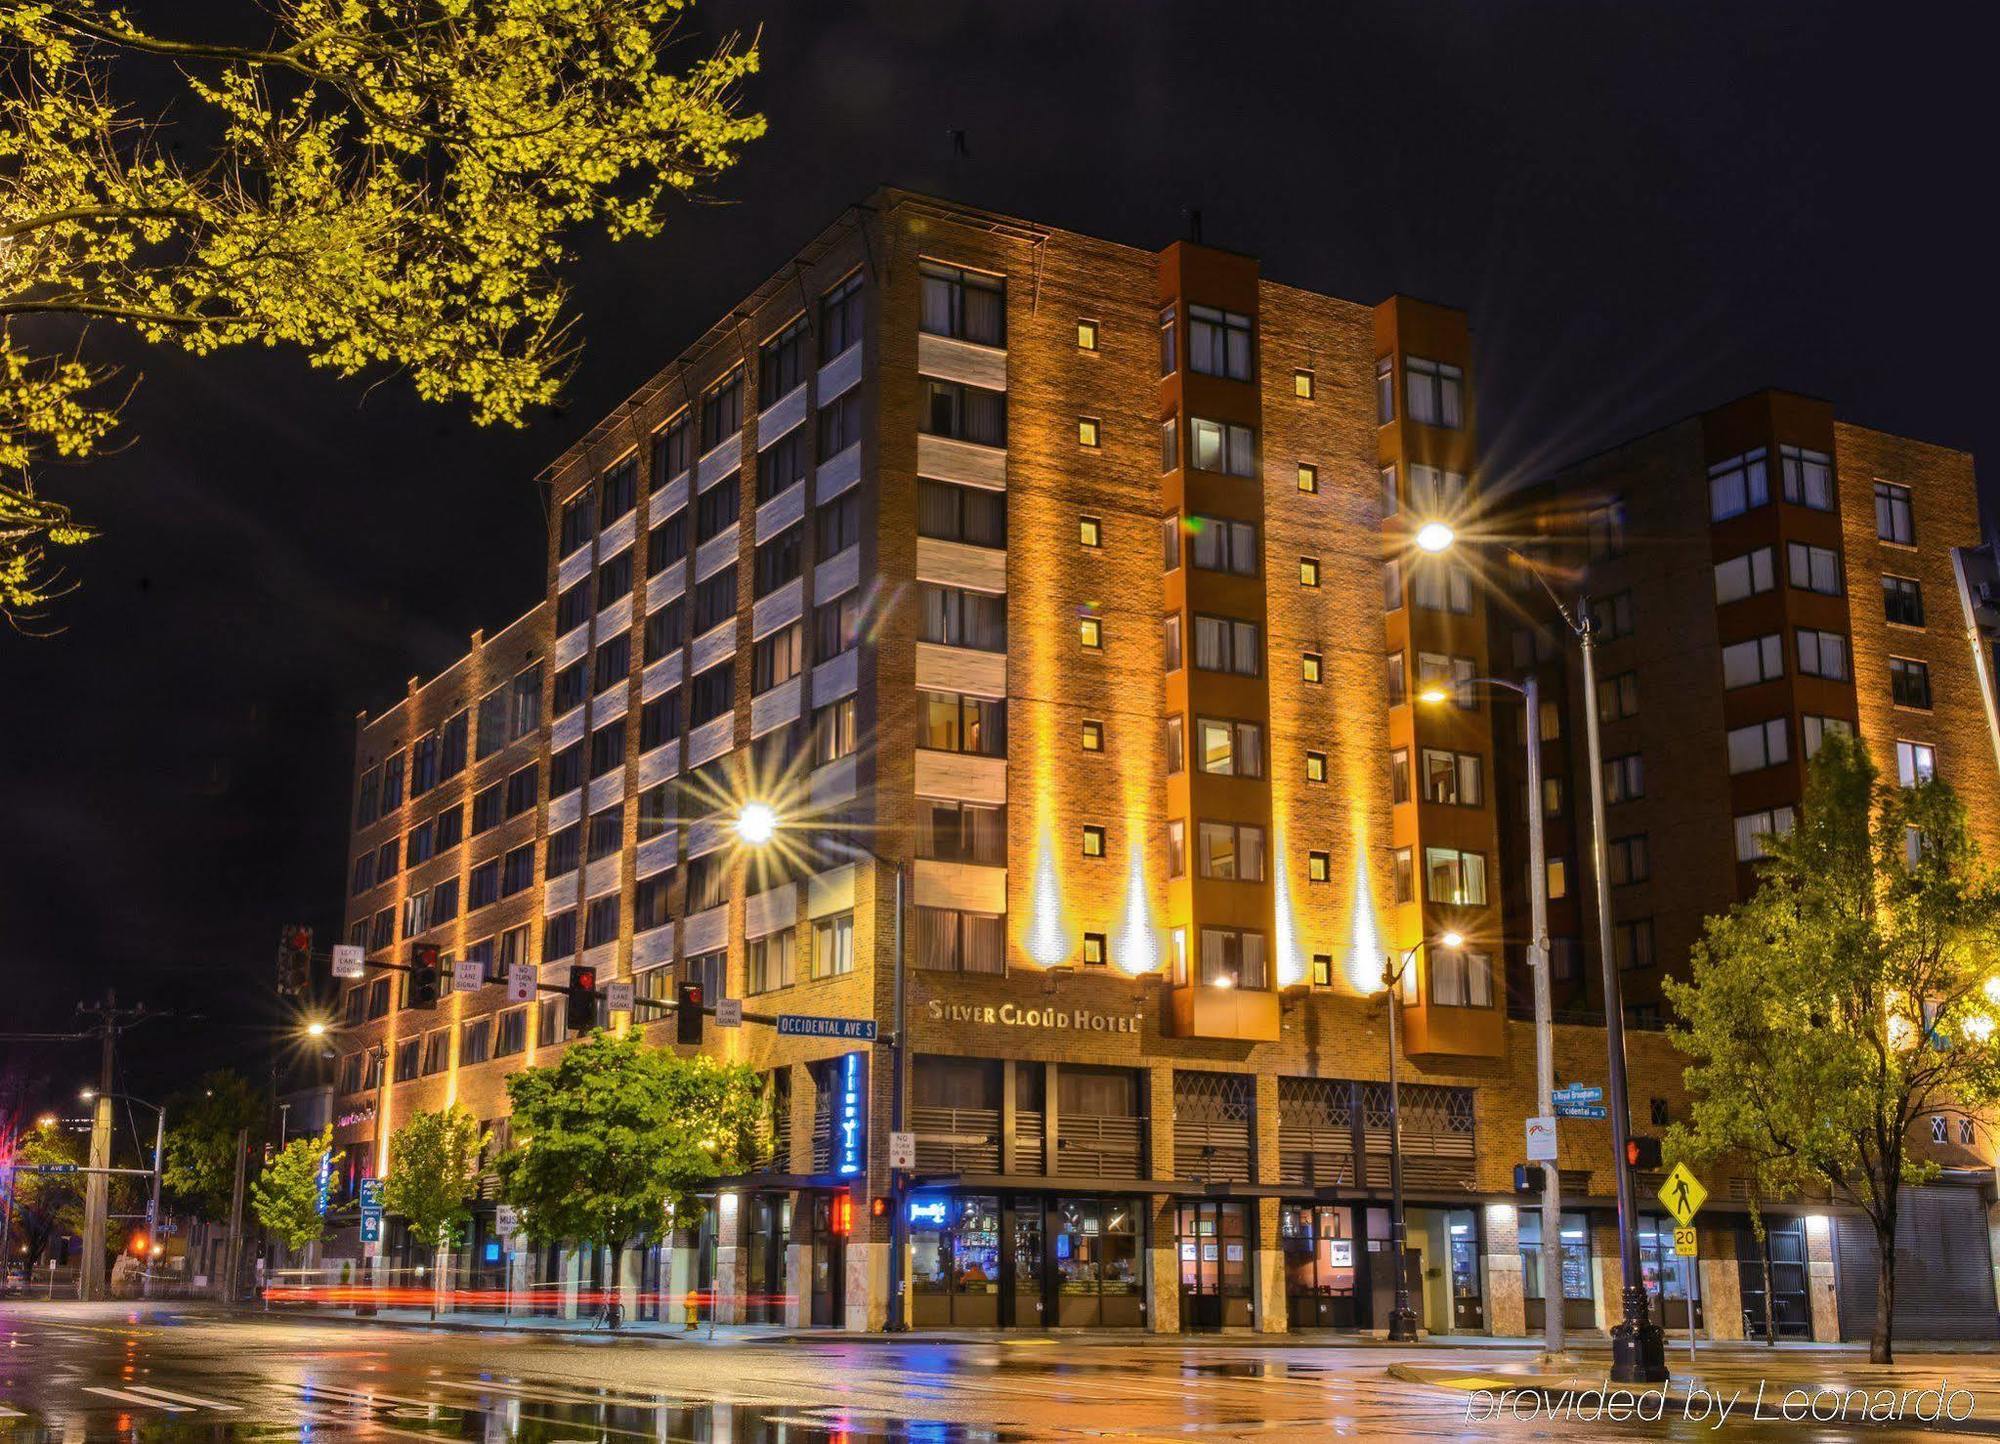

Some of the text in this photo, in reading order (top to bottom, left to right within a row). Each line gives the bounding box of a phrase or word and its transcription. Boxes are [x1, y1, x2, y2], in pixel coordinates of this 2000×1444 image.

[515, 974, 532, 982] TURN
[456, 981, 479, 989] SIGNAL
[928, 1000, 1138, 1033] SILVER CLOUD HOTEL
[781, 1018, 873, 1037] OCCIDENTAL AVE S
[499, 1215, 517, 1224] MUS
[1676, 1231, 1694, 1244] 20
